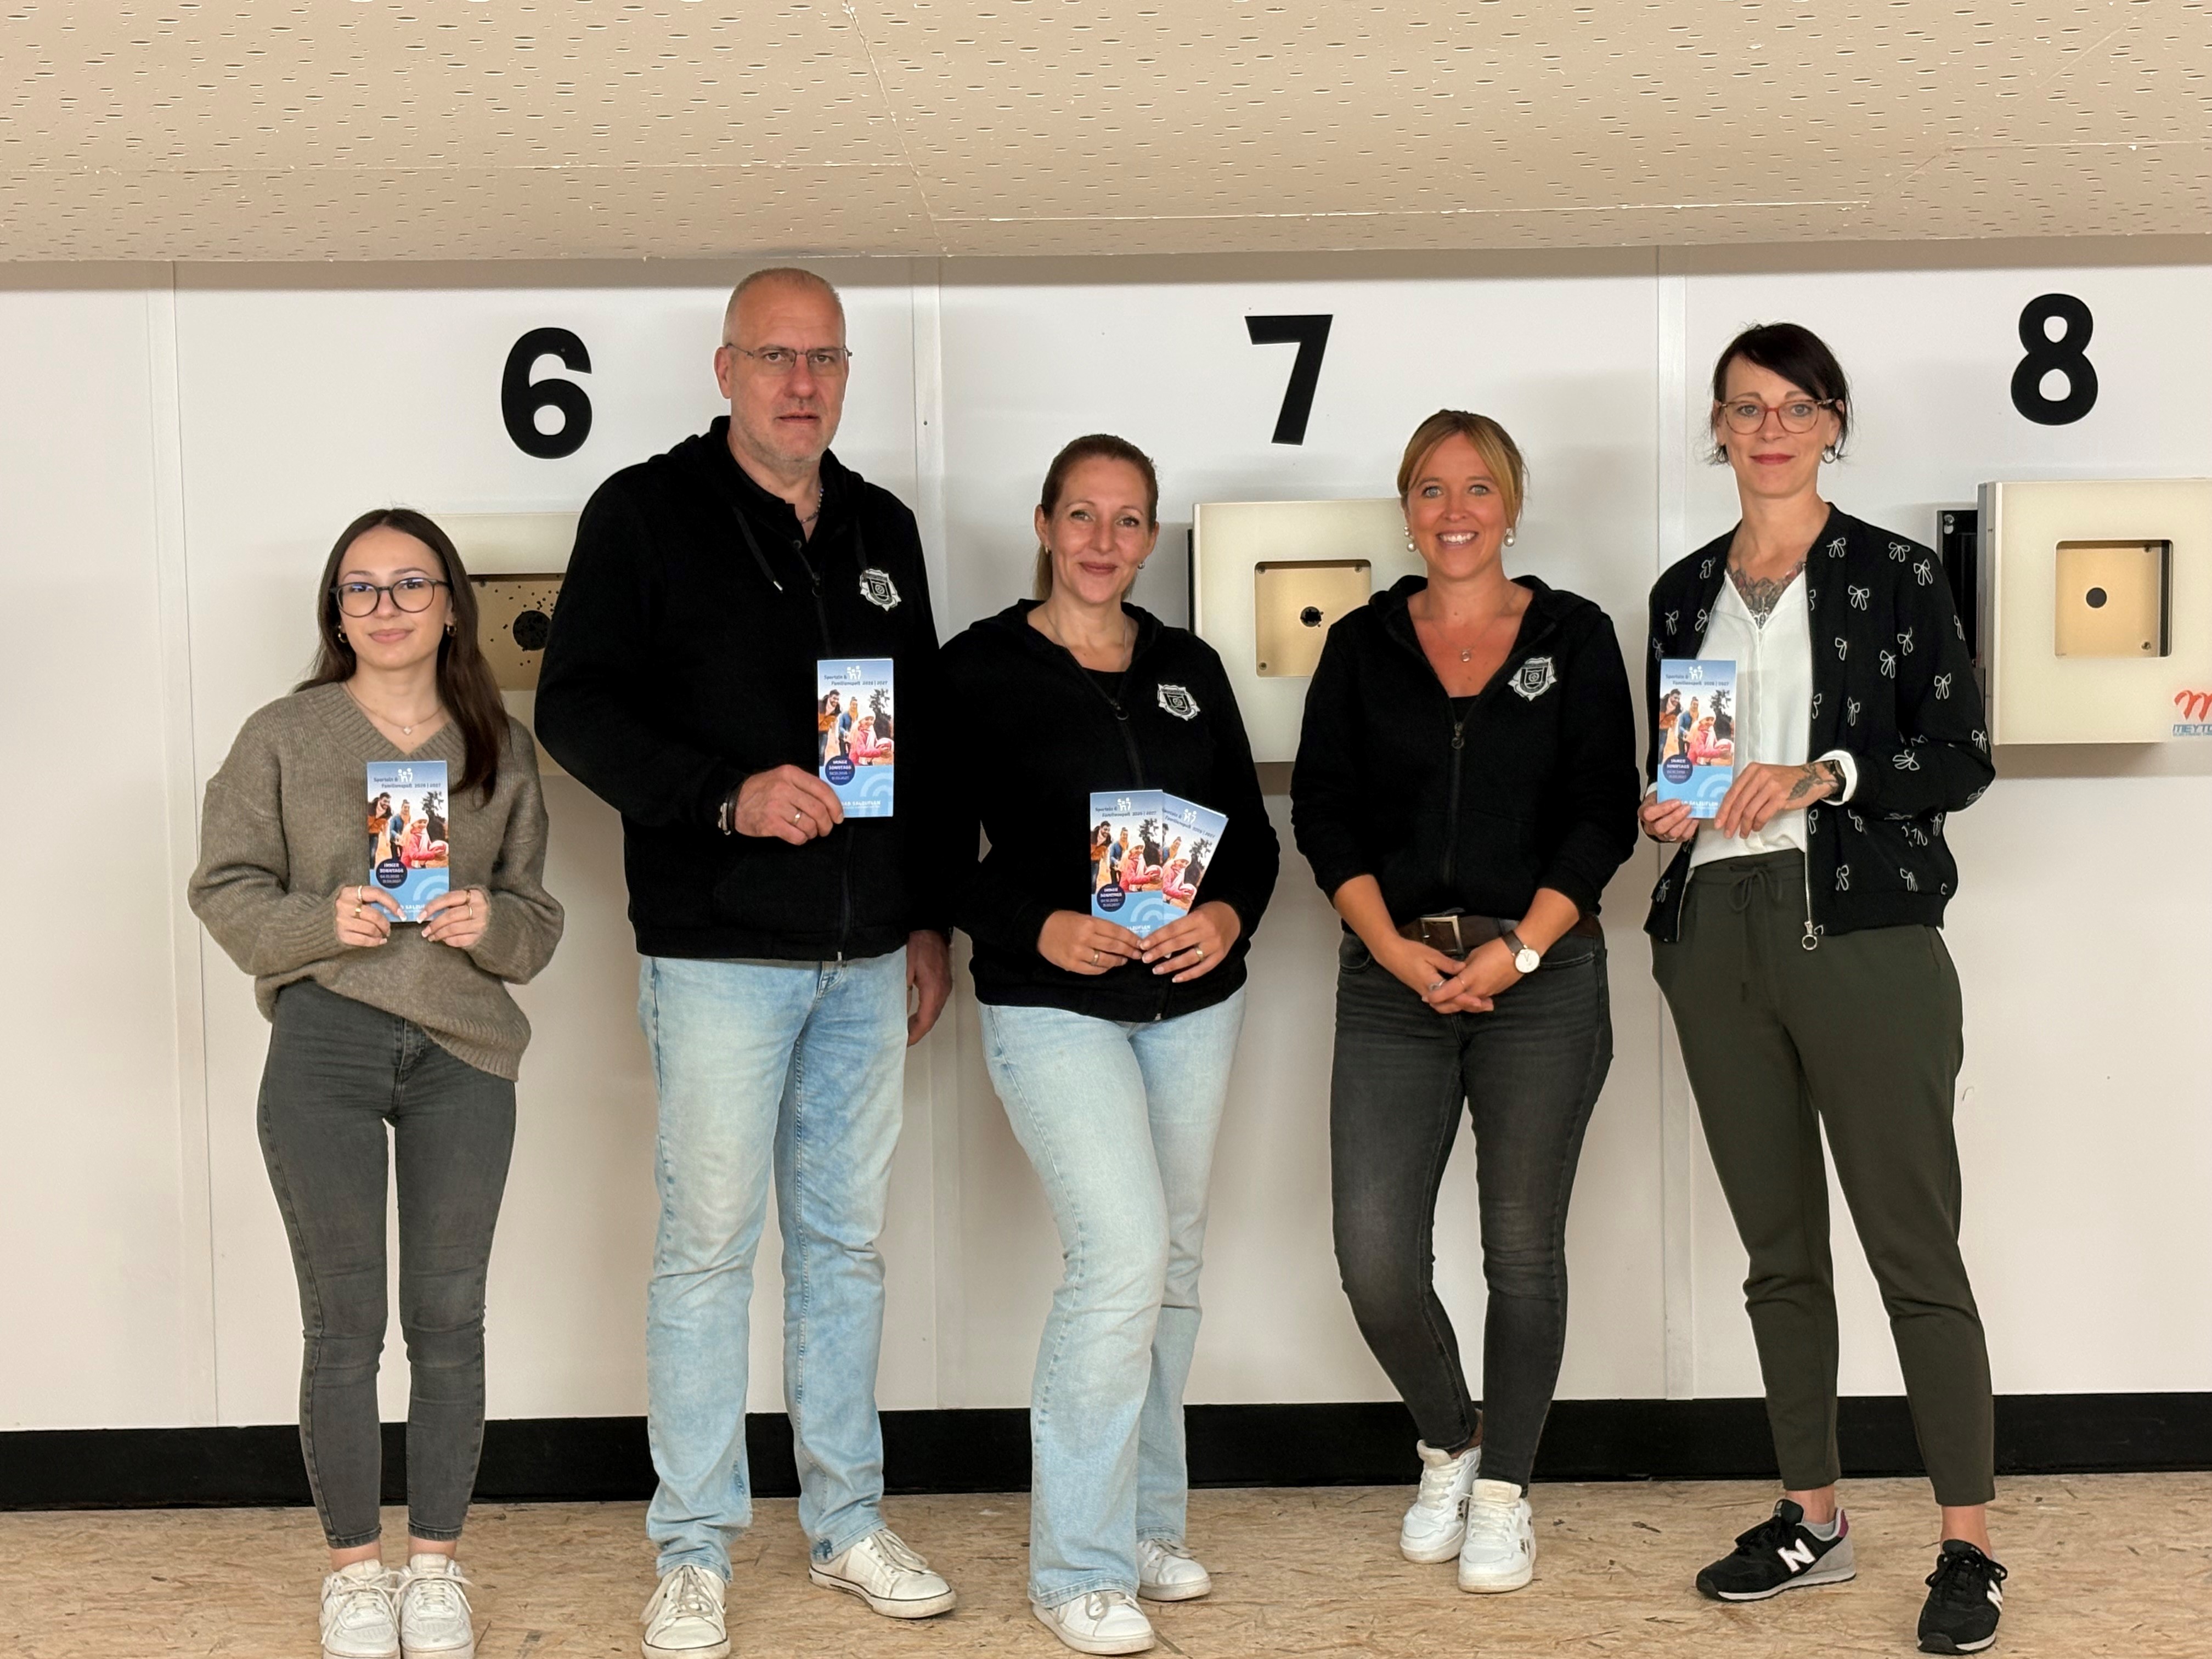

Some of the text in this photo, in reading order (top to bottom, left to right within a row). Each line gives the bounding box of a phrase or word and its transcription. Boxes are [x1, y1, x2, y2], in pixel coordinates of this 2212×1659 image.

[501, 328, 592, 459] 6
[1244, 314, 1333, 445] 7
[2011, 294, 2098, 425] 8
[1777, 1538, 1816, 1573] N
